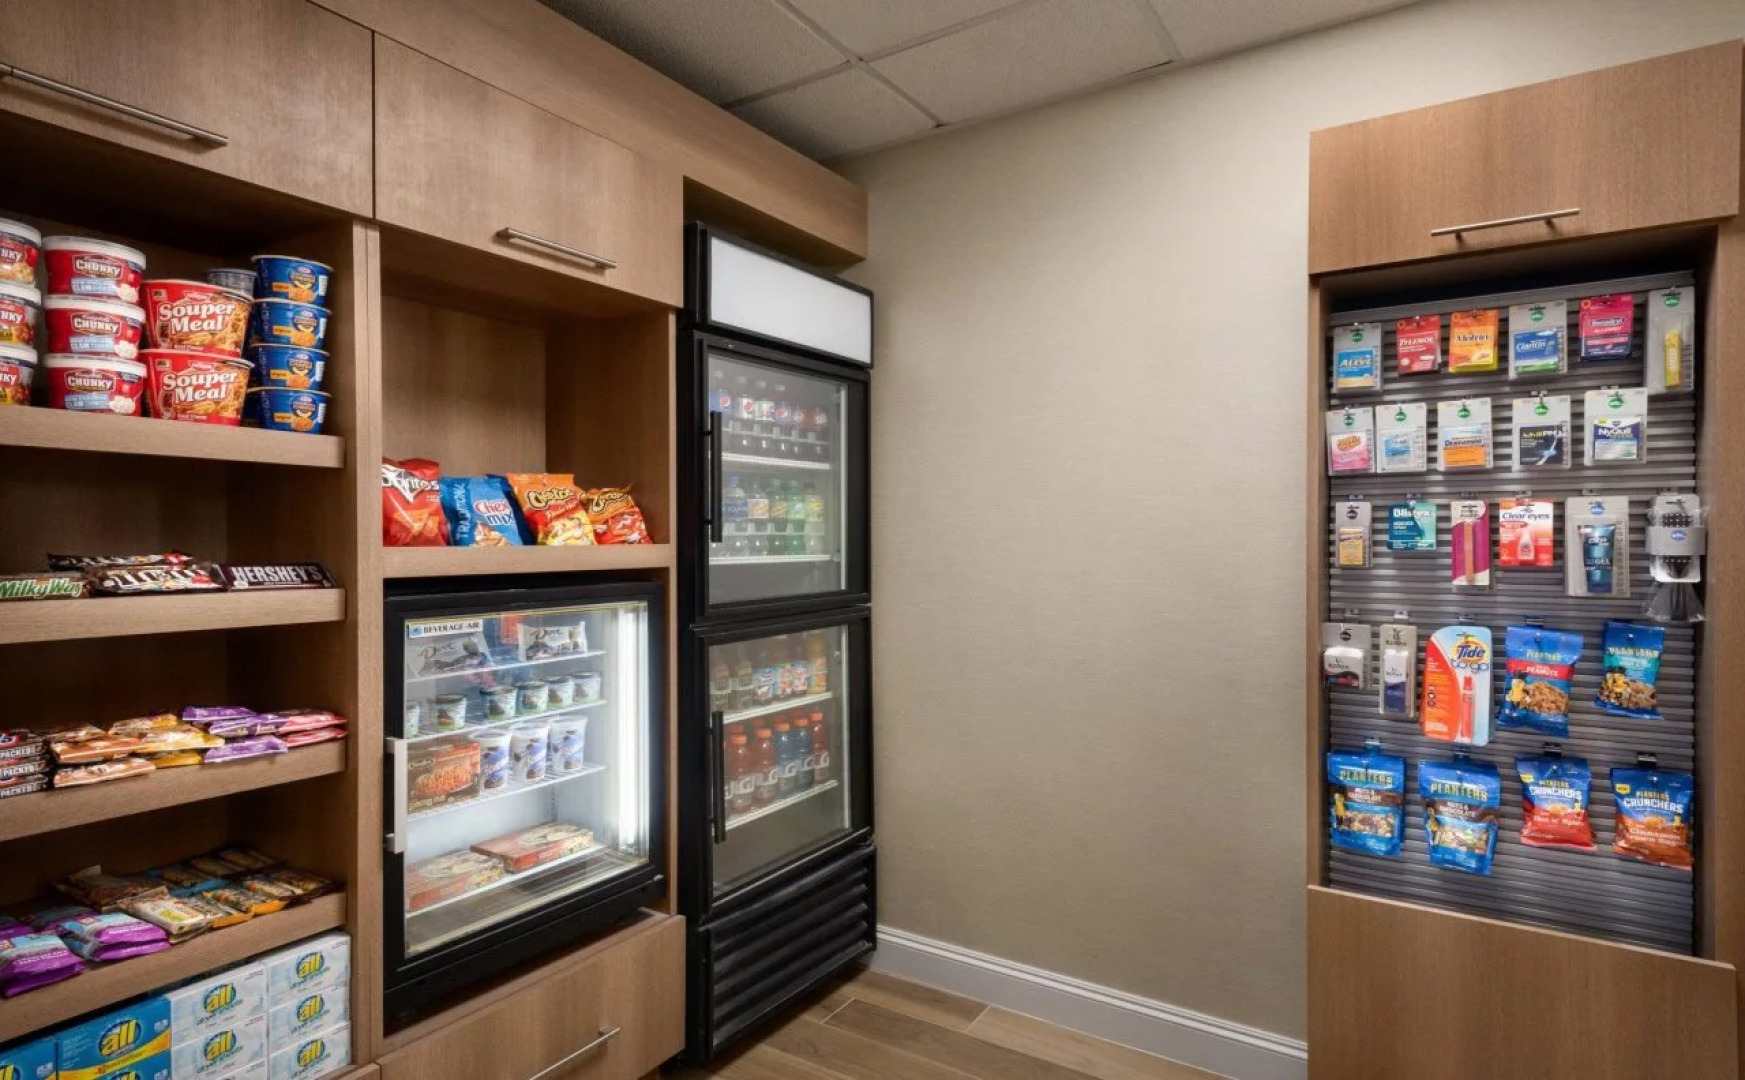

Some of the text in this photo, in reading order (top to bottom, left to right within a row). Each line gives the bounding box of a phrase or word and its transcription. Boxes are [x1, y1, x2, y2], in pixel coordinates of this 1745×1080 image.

[75, 258, 121, 276] CHUNKY
[159, 302, 236, 320] Souper
[74, 318, 119, 333] CHUNKY
[170, 315, 224, 334] Meal
[1516, 339, 1546, 350] Claritin
[67, 377, 112, 389] CHUNKY
[162, 371, 238, 390] Souper
[175, 384, 228, 403] Meal
[473, 499, 511, 515] Chex
[231, 565, 323, 582] HERSHEY'S
[1456, 644, 1487, 660] Tide
[1339, 769, 1393, 787] PLANTERS
[1430, 782, 1488, 802] PLANTERS
[1529, 786, 1582, 800] CRUNCHERS
[1624, 798, 1684, 813] CRUNCHERS
[299, 952, 322, 979] all
[206, 983, 233, 1013] all
[299, 994, 322, 1022] all
[101, 1019, 137, 1056] all
[206, 1029, 233, 1062] all
[299, 1038, 323, 1067] all
